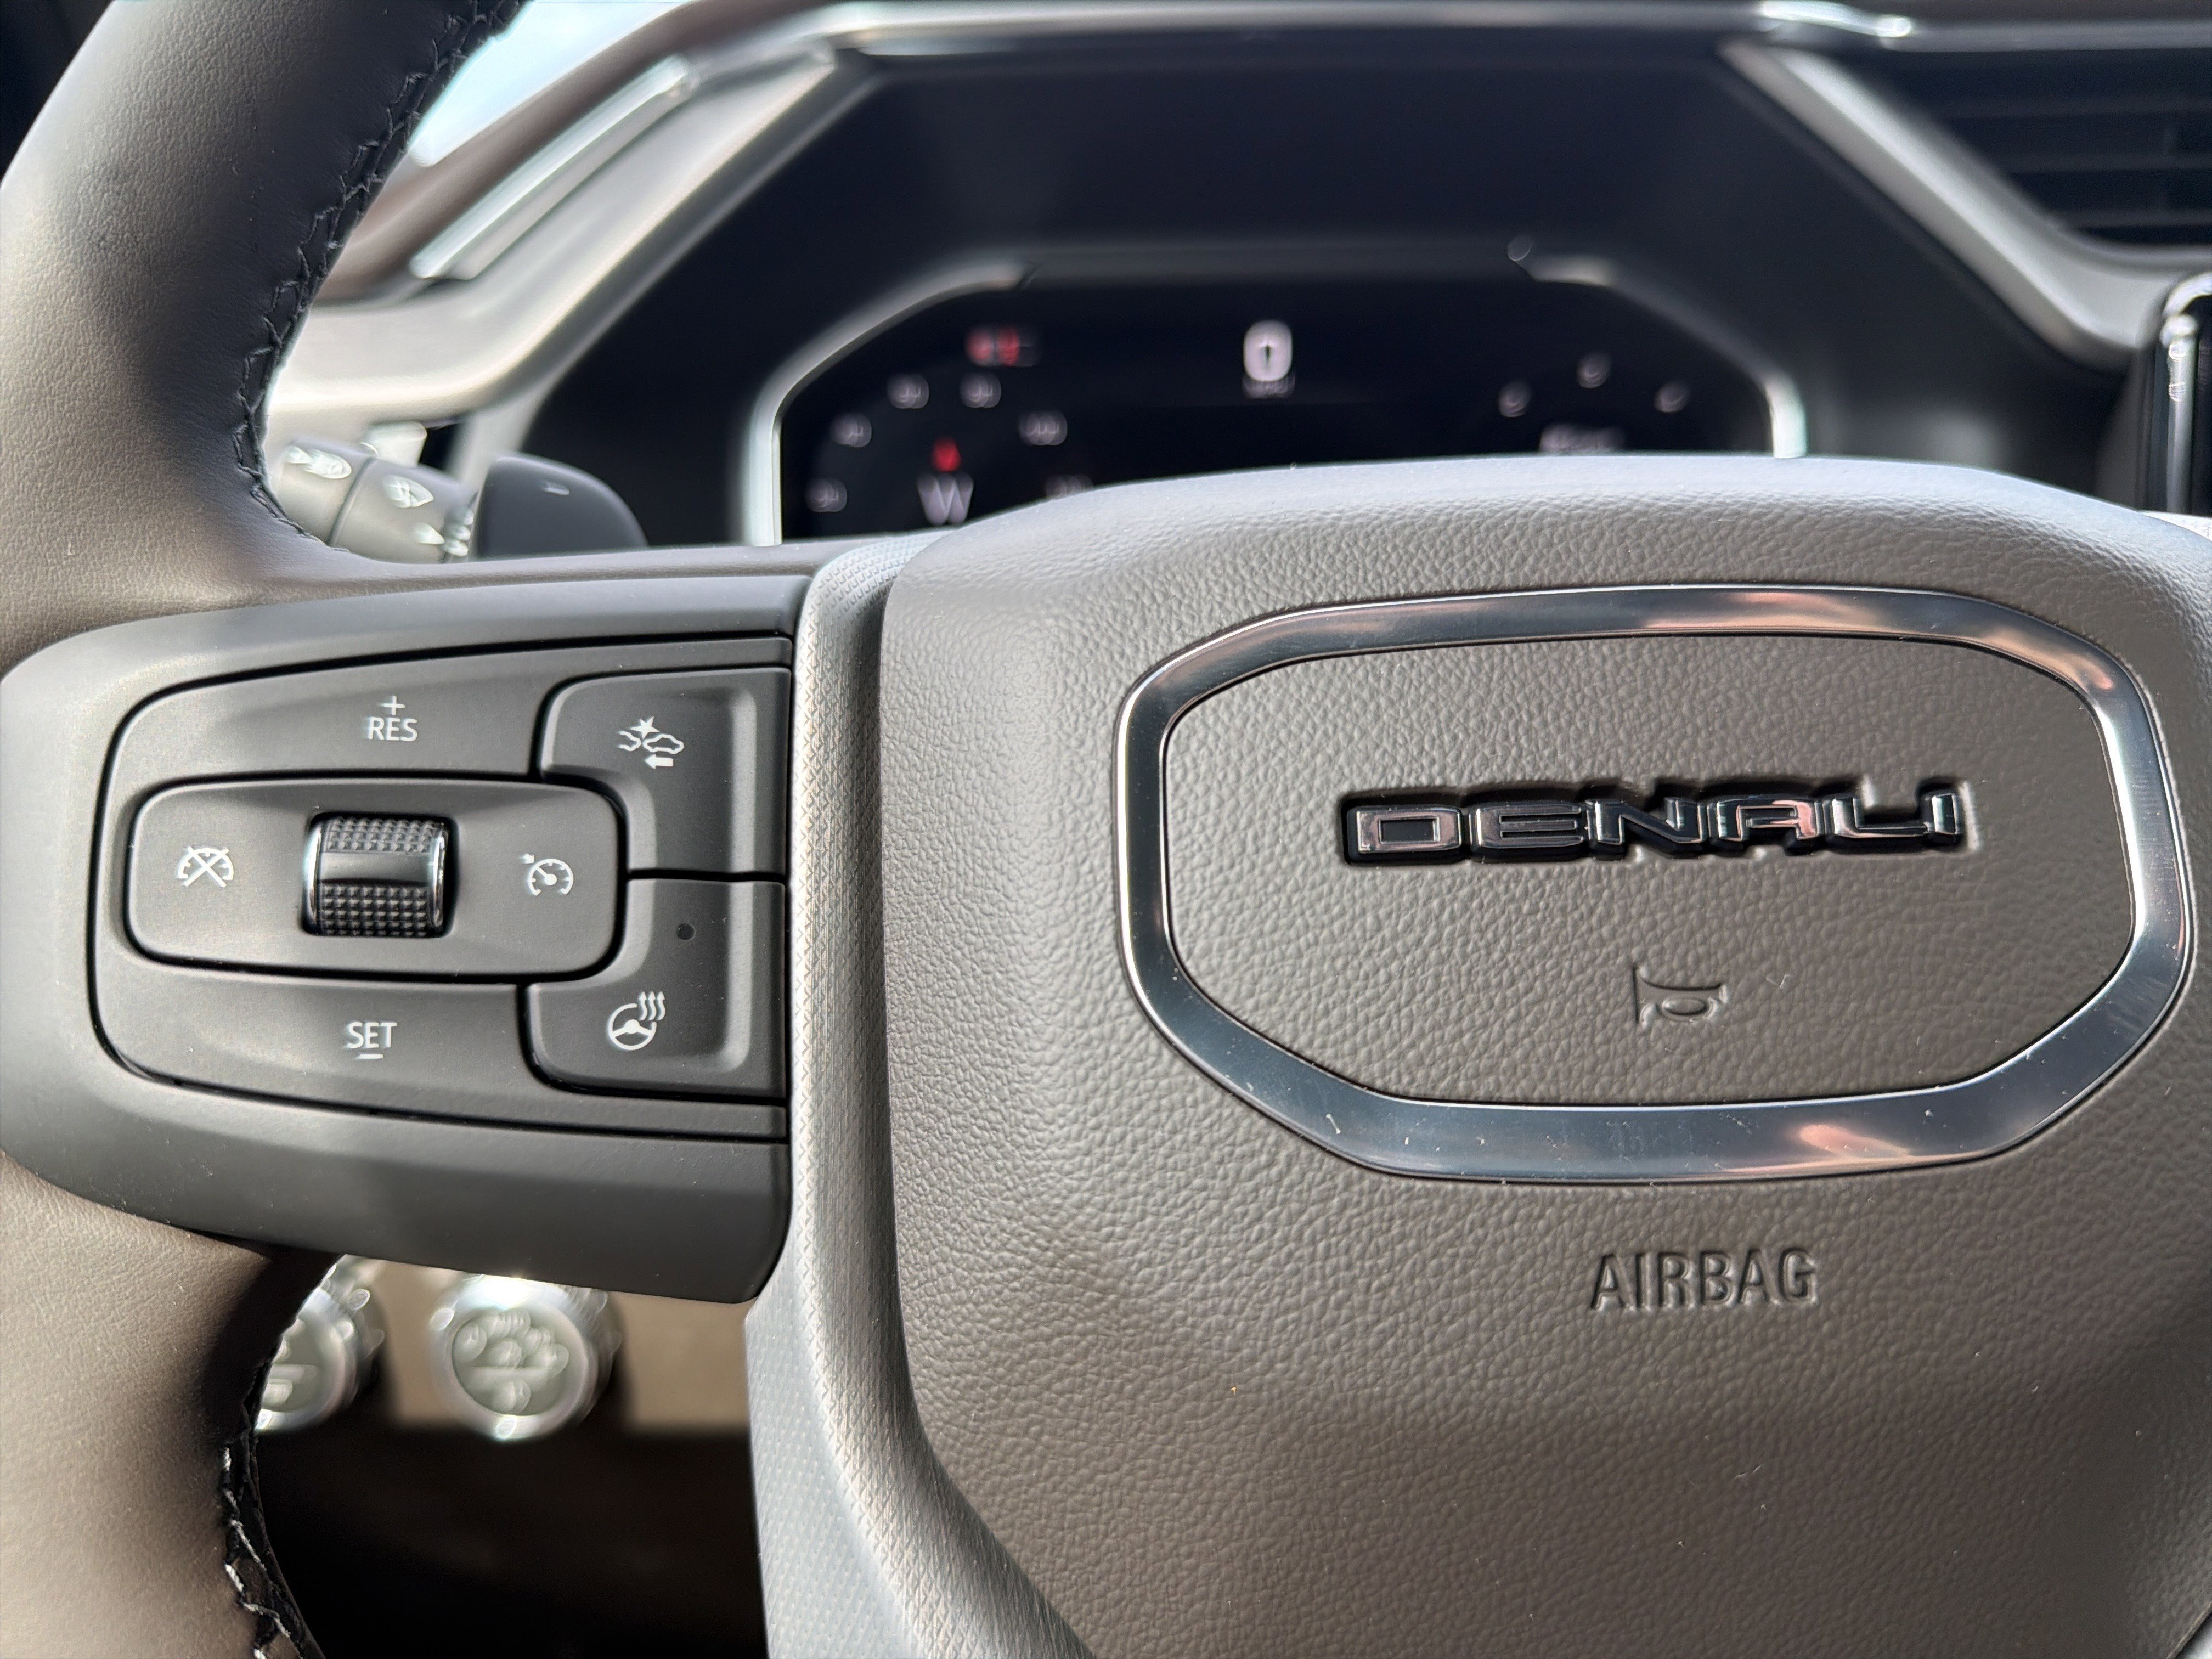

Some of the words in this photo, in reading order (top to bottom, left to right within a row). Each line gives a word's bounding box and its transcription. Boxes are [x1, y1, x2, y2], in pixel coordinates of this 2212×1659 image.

[364, 716, 419, 743] RES
[1347, 789, 1968, 860] DENALI
[346, 1021, 398, 1050] SET
[1590, 1248, 1820, 1312] AIRBAG
